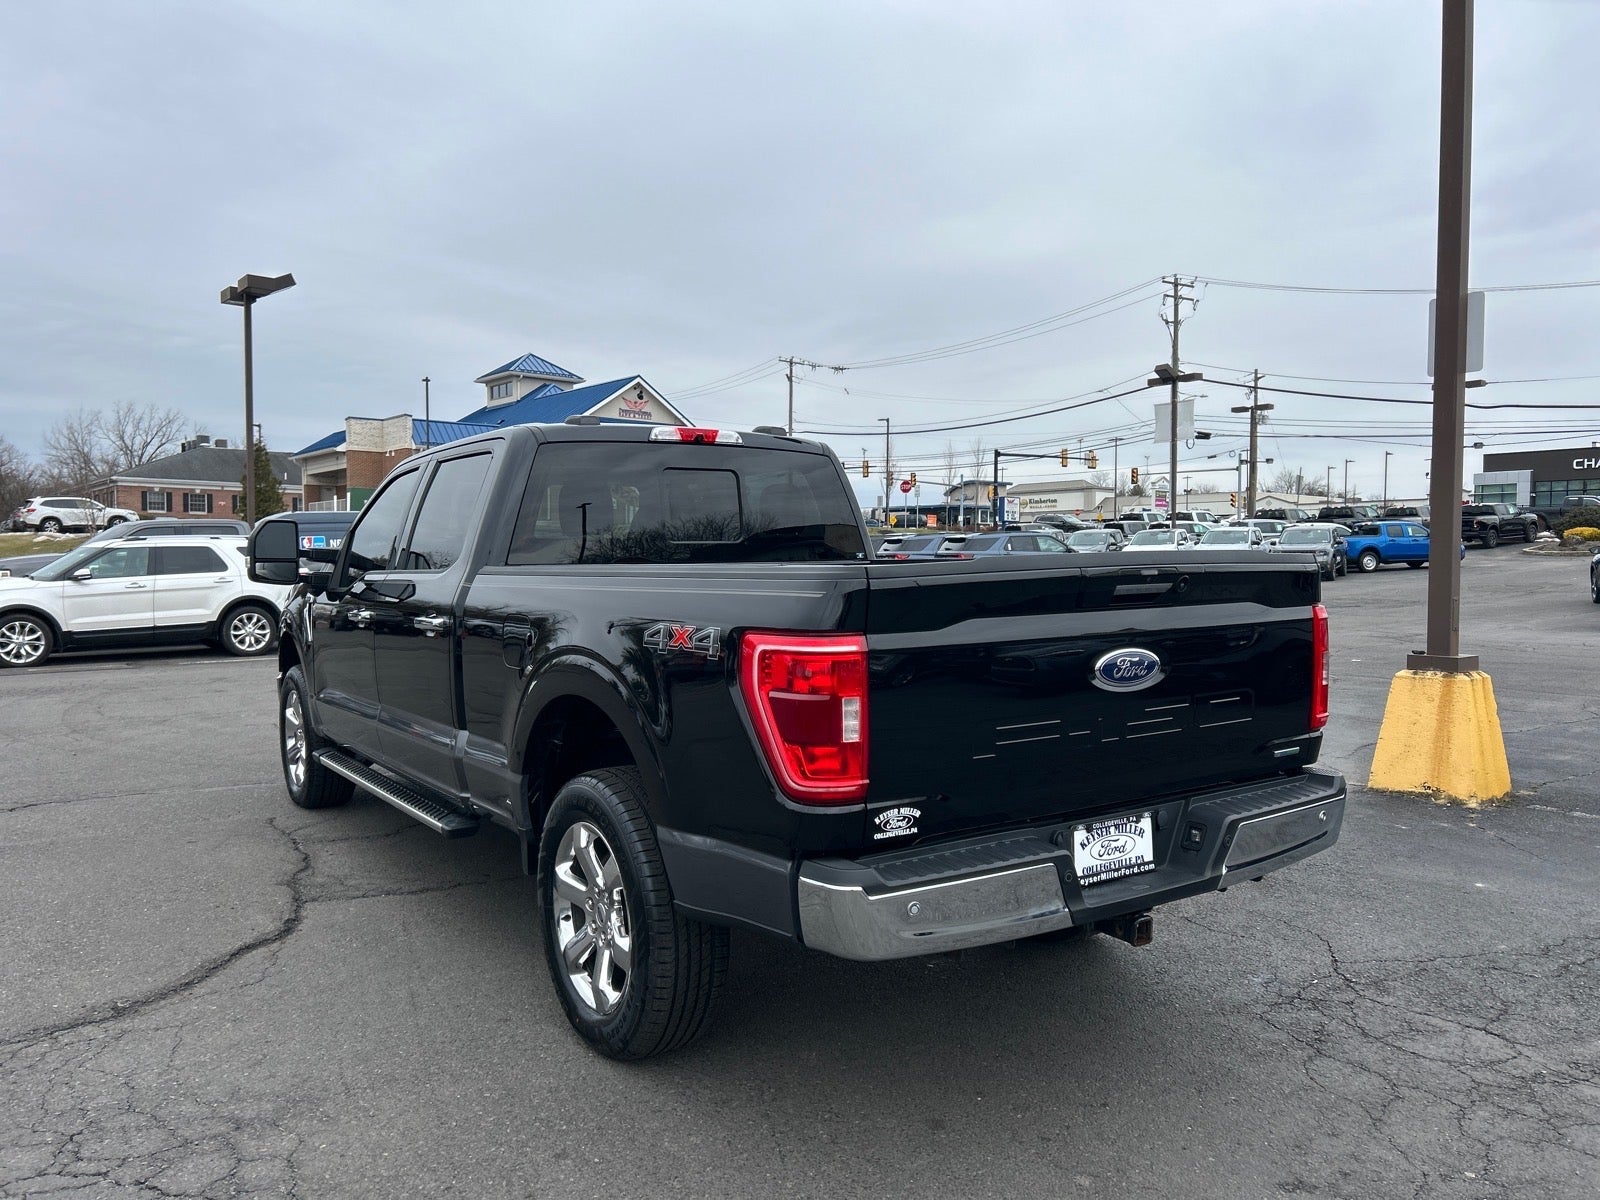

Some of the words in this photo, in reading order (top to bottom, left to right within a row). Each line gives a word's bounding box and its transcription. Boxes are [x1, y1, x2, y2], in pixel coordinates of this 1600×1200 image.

[1114, 656, 1148, 679] Ford
[874, 808, 898, 825] KEYSER
[900, 807, 921, 818] MILLER
[887, 816, 908, 829] Ford
[1080, 826, 1112, 851] KEYSER
[1114, 823, 1145, 839] MILLER
[1098, 838, 1127, 858] Ford
[1078, 863, 1155, 886] eyserMillerFord.com
